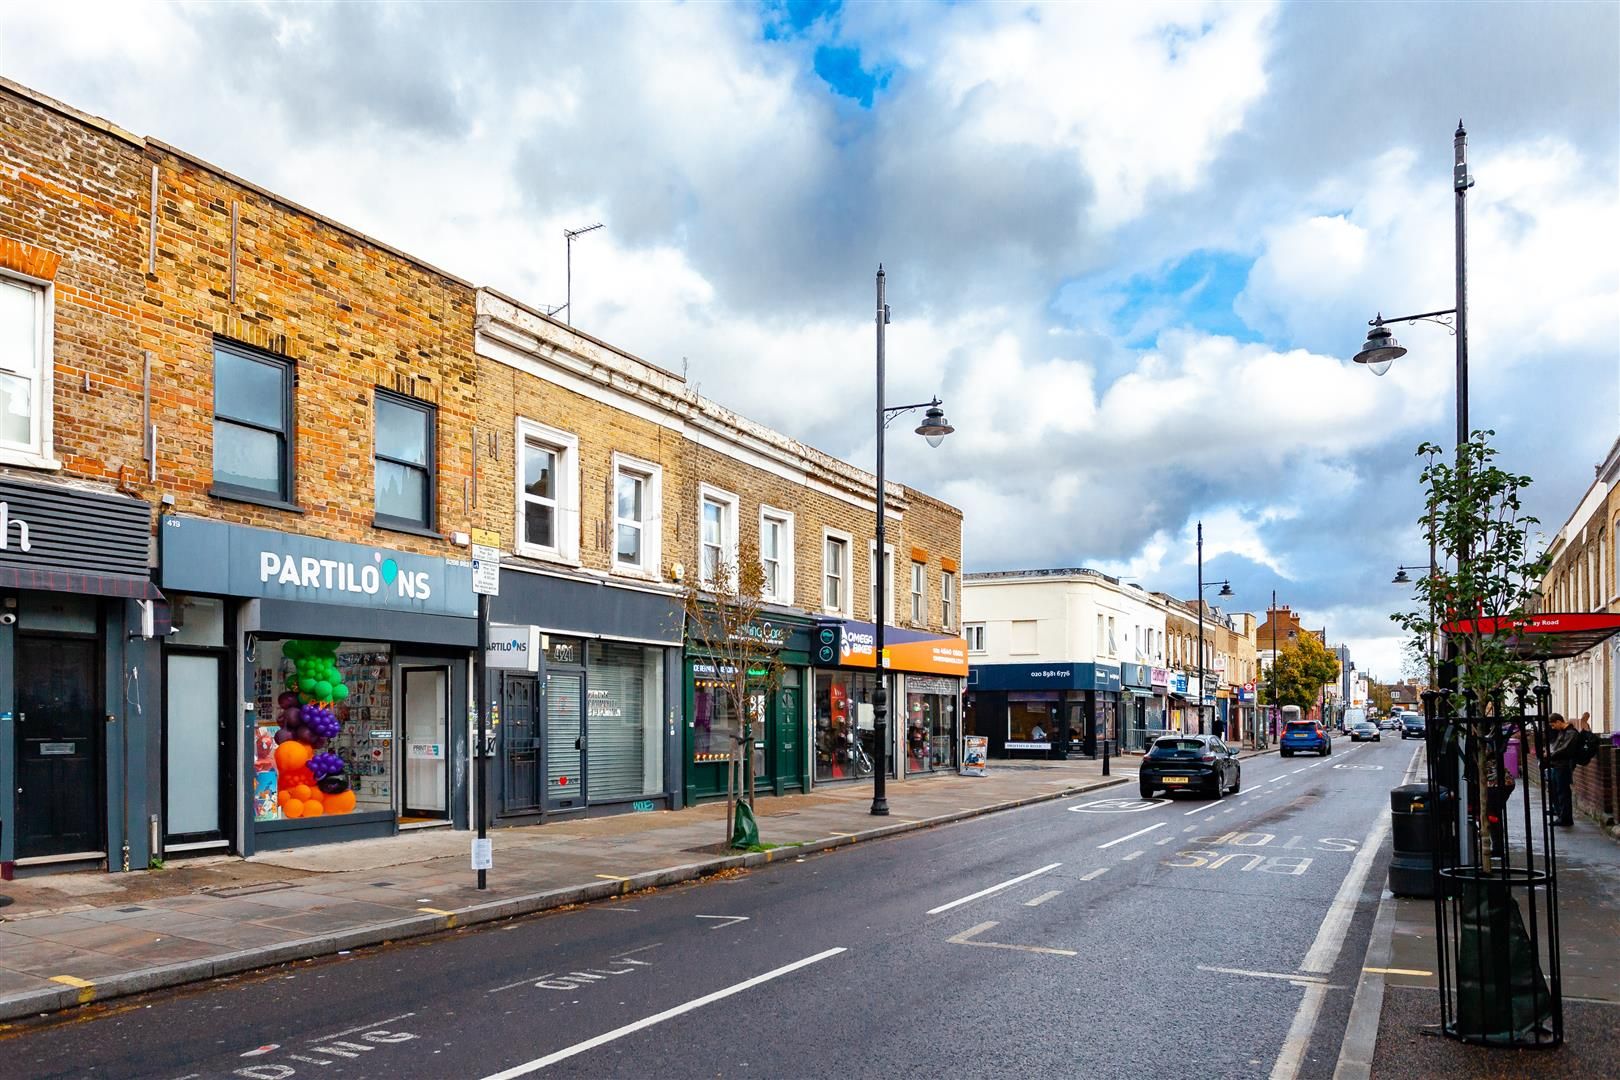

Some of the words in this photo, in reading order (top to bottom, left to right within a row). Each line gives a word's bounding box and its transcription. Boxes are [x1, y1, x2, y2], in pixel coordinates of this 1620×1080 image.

[167, 519, 180, 528] 419
[848, 632, 873, 645] OMEGA
[554, 644, 574, 661] 421
[853, 643, 873, 655] BIKES
[1056, 670, 1071, 678] 6776
[535, 958, 654, 990] ONLY
